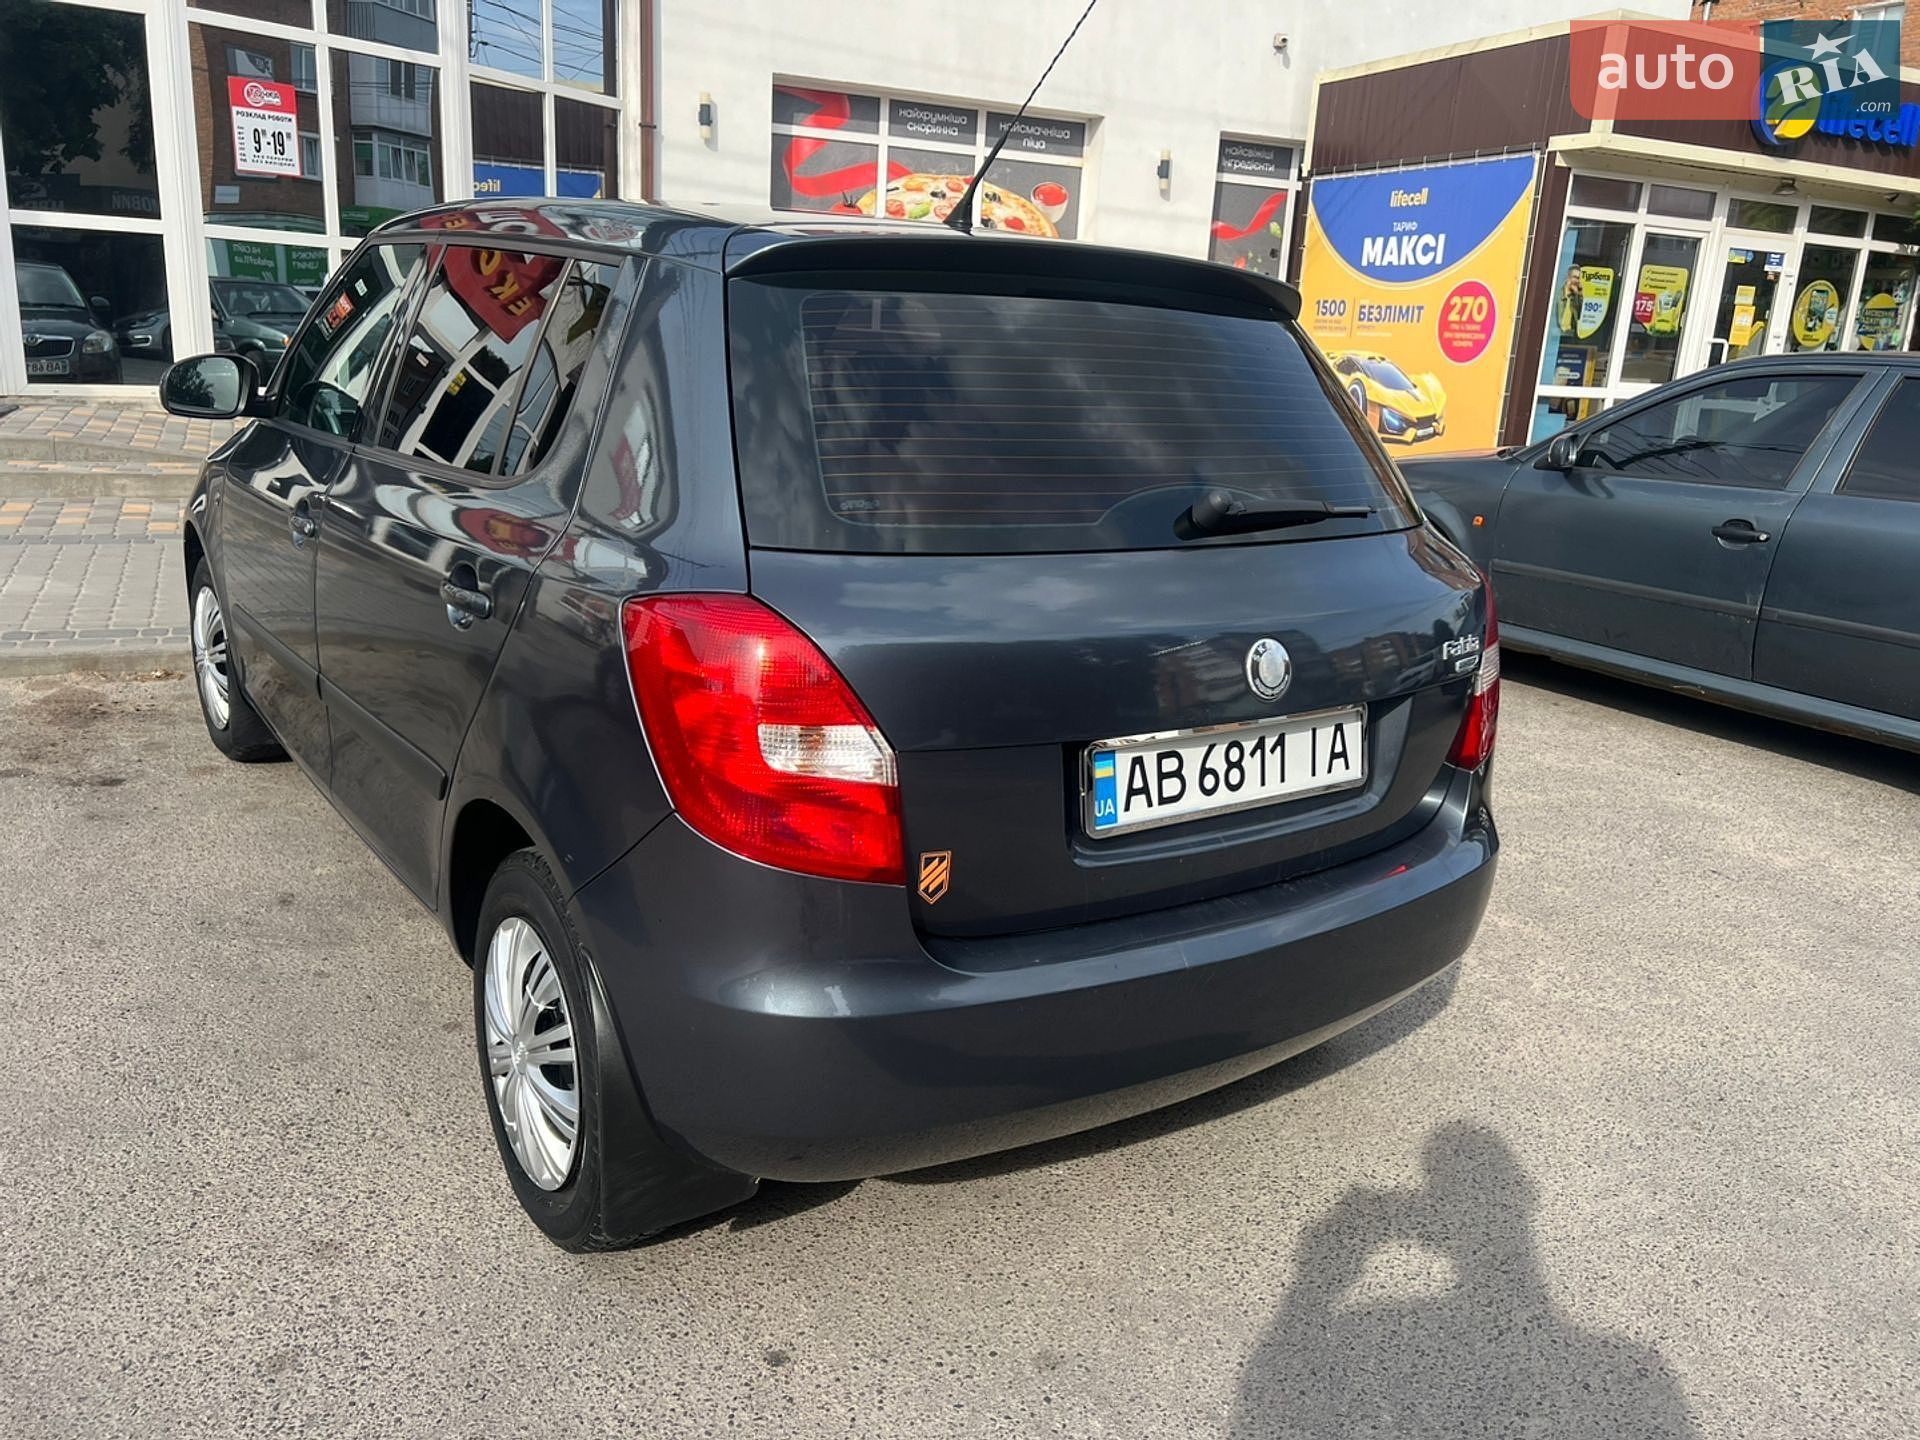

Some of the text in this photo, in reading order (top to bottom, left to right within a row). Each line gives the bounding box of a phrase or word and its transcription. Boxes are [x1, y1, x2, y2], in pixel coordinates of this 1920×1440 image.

[236, 110, 266, 121] РОЗКЛАД
[1390, 187, 1429, 208] lifecell
[1393, 221, 1418, 232] ТАРИФ
[1361, 233, 1446, 267] МАКСІ
[1316, 299, 1347, 317] 1500
[1358, 304, 1425, 324] БЕЗЛІМІТ
[1447, 295, 1488, 322] 270
[1124, 722, 1350, 813] AB 6811 IA
[1095, 802, 1115, 817] UA
